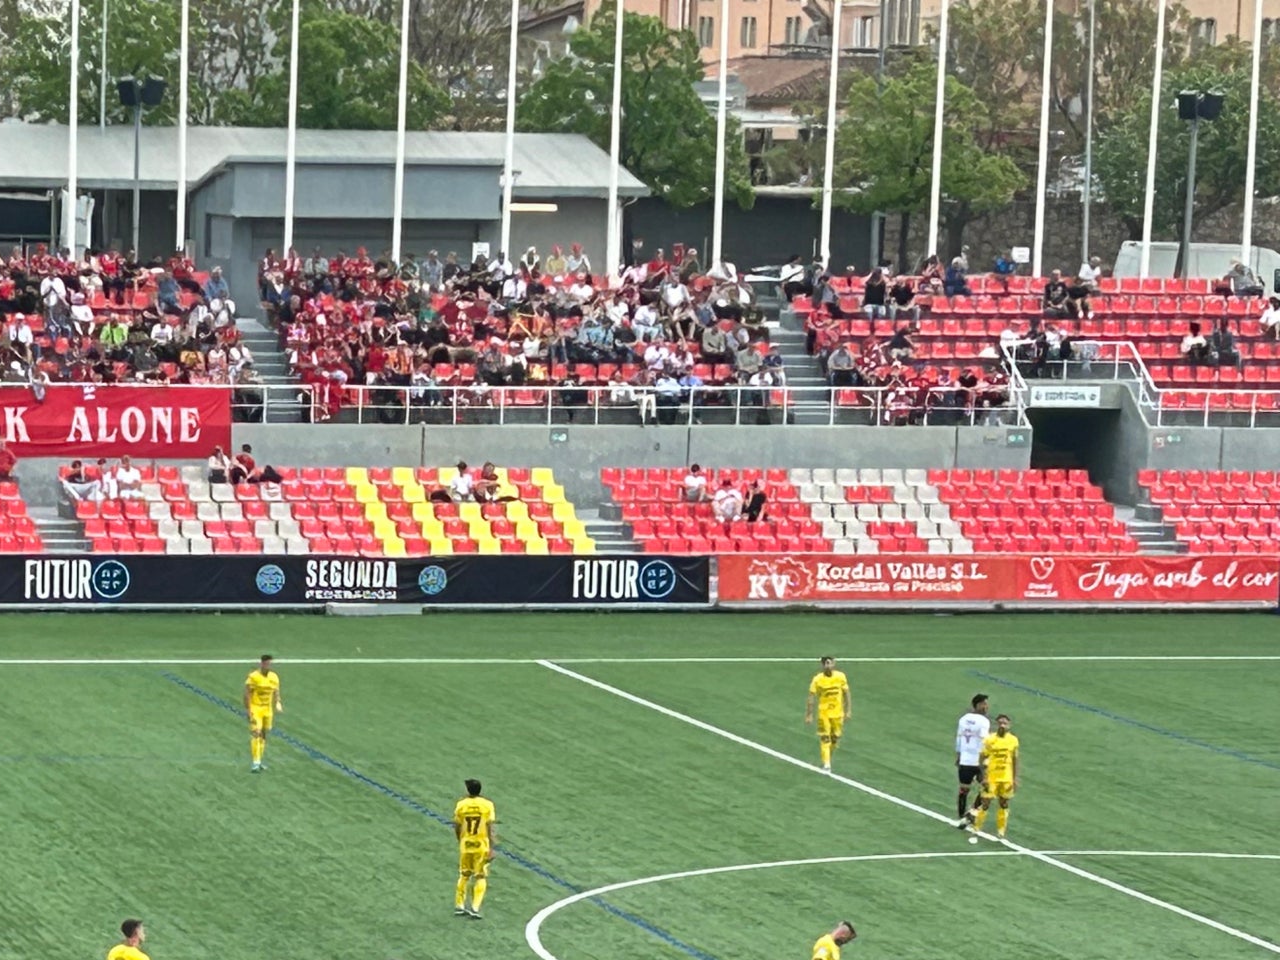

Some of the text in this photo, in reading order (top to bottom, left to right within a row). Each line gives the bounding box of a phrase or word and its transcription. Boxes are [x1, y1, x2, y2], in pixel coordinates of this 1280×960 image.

[66, 406, 201, 443] ALONE
[24, 559, 92, 599] FUTUR
[305, 560, 397, 588] SEGUNDA
[573, 560, 639, 599] FUTUR
[1078, 561, 1278, 598] Juga amb el cor
[464, 816, 481, 835] 17
